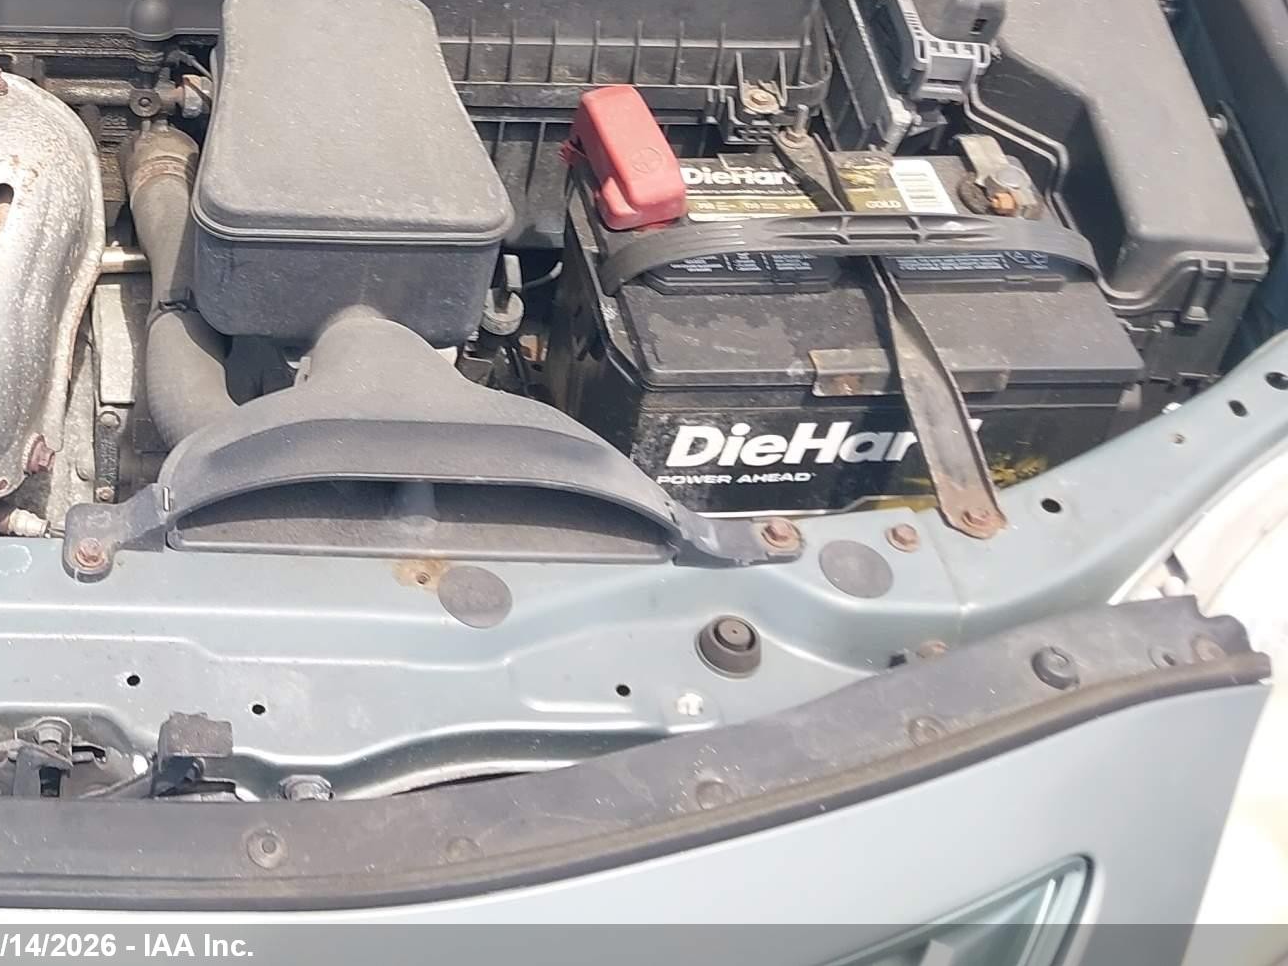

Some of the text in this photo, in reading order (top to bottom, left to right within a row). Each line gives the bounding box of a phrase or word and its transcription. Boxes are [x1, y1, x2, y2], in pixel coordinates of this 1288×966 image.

[865, 200, 902, 209] GOLD
[665, 419, 983, 468] DieHar
[656, 472, 813, 486] POWER AHEAD
